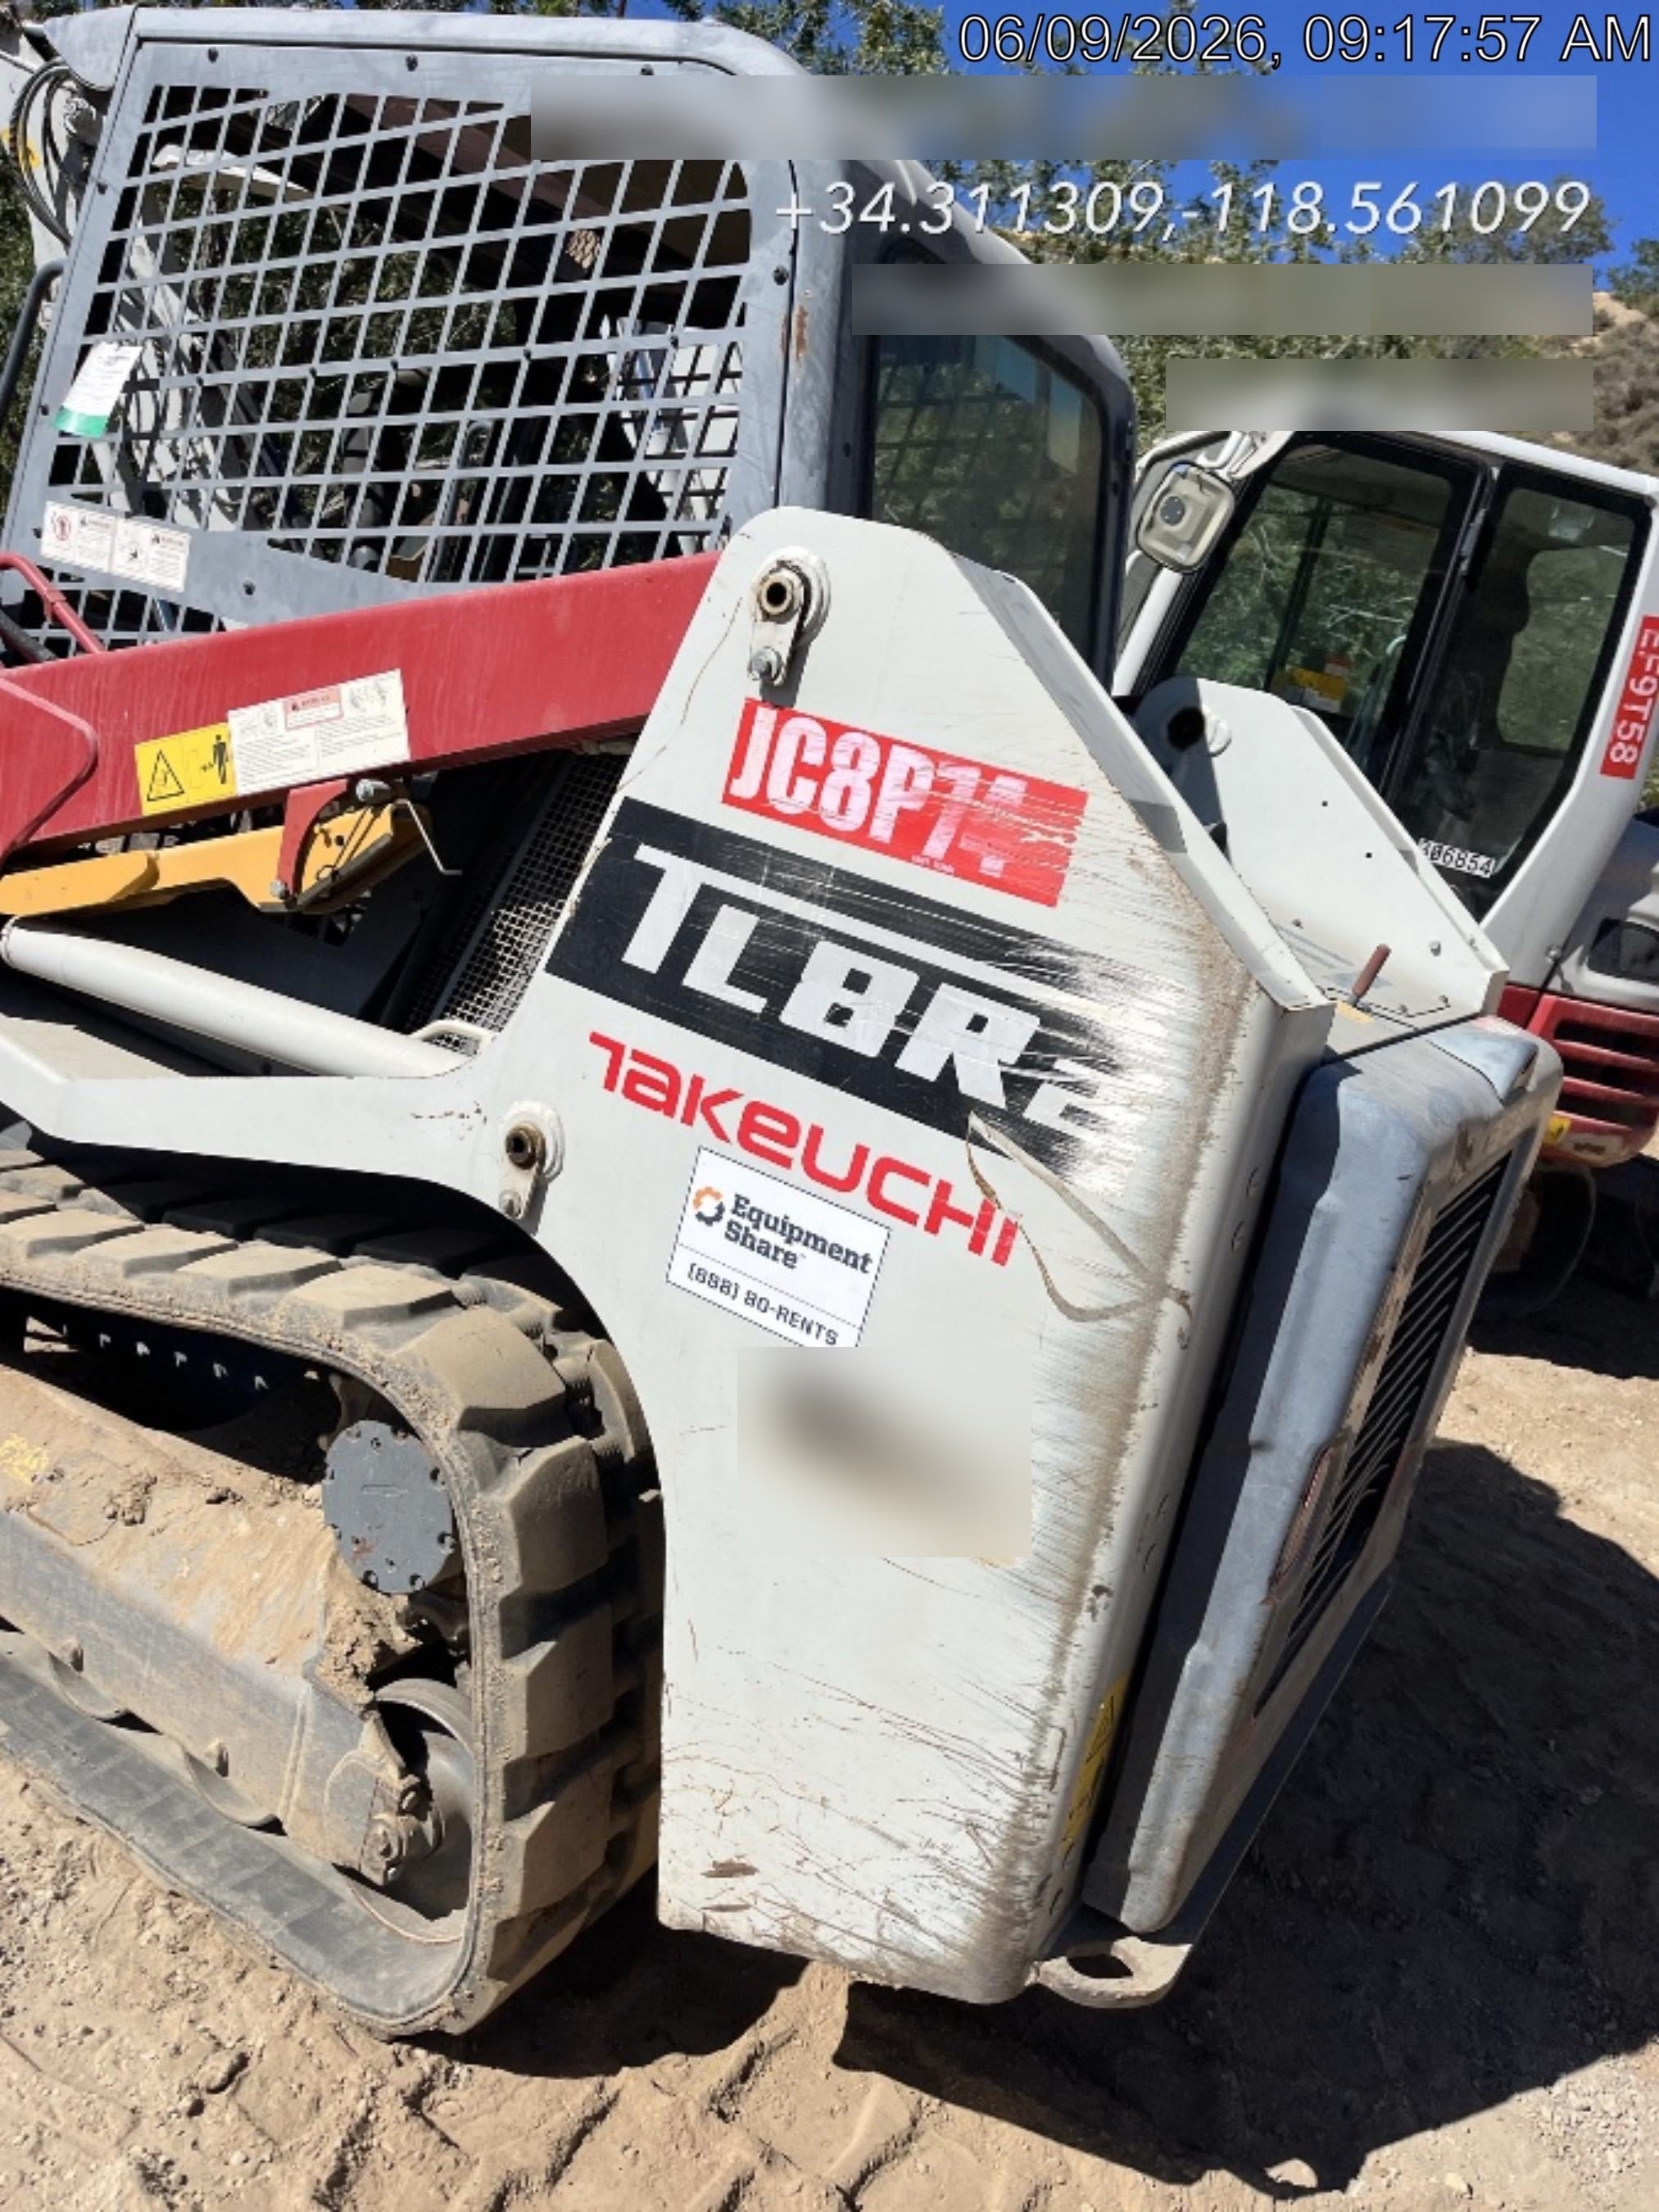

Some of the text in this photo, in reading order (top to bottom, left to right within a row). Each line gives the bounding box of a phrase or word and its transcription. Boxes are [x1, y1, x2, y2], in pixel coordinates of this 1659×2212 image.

[730, 1193, 873, 1274] Equipment
[687, 1262, 840, 1347] (888) 80-RENTS
